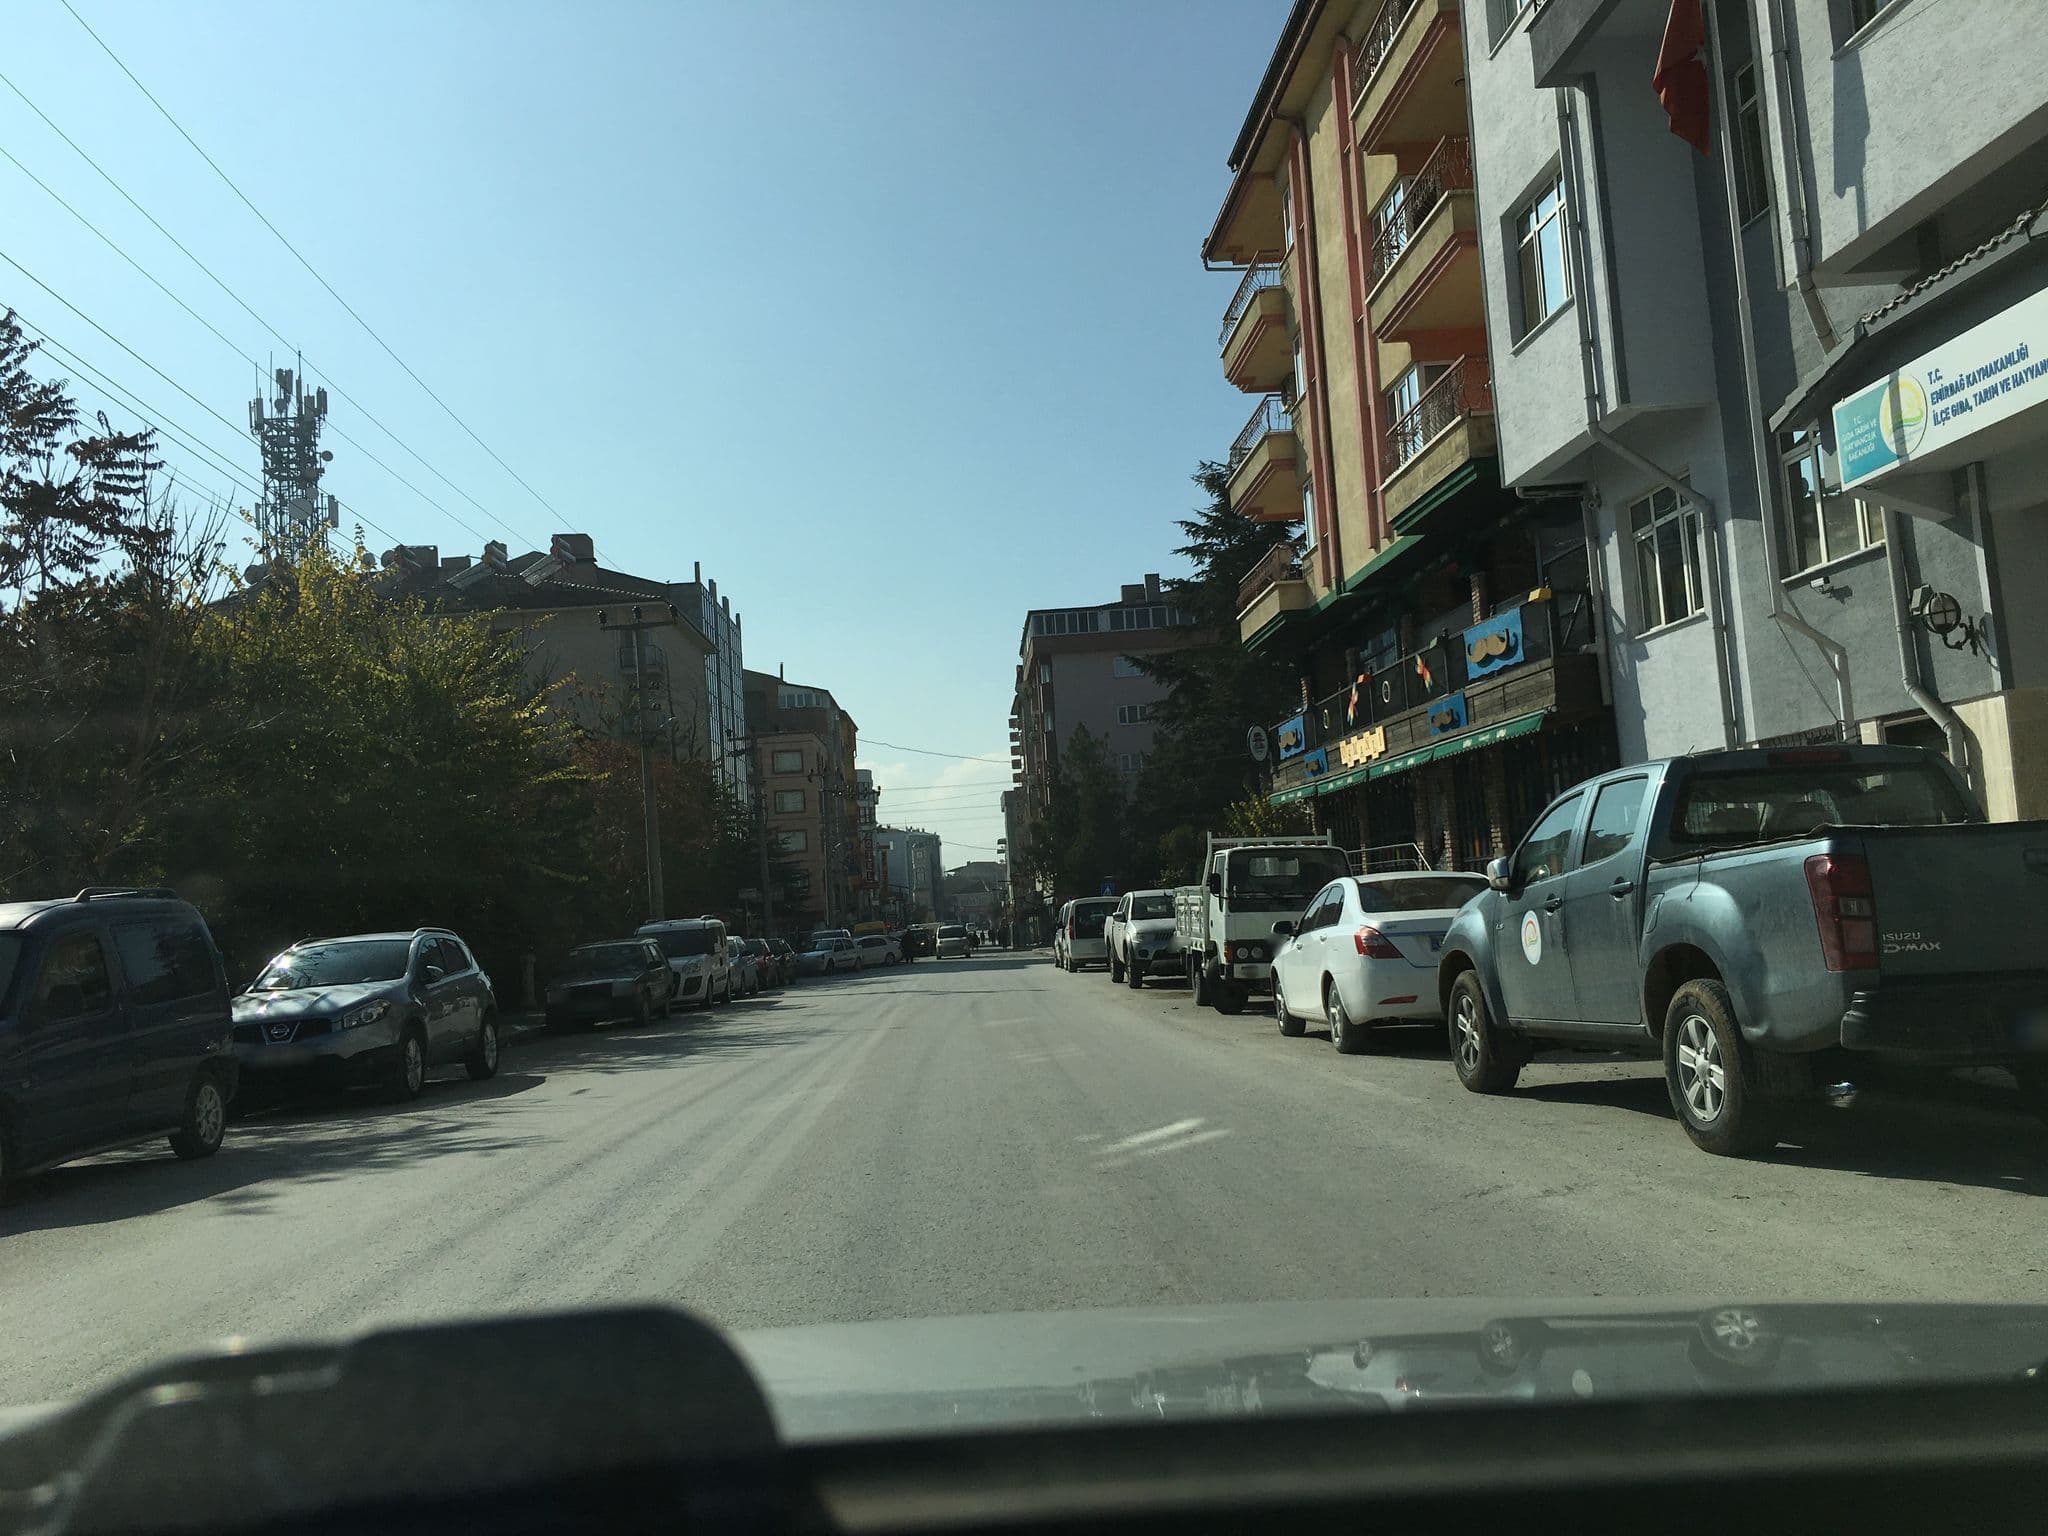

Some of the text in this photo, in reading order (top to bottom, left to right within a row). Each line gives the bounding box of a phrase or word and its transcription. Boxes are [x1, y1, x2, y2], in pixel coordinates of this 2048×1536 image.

[1927, 368, 1943, 385] T.C.
[1965, 342, 2029, 388] KAYMAKAMLIĞI
[1932, 403, 1951, 427] İLÇE
[1972, 382, 1999, 408] TARIM
[1998, 376, 2012, 394] VE
[2011, 358, 2048, 389] HAYVAN
[1882, 931, 1921, 942] ISUZU
